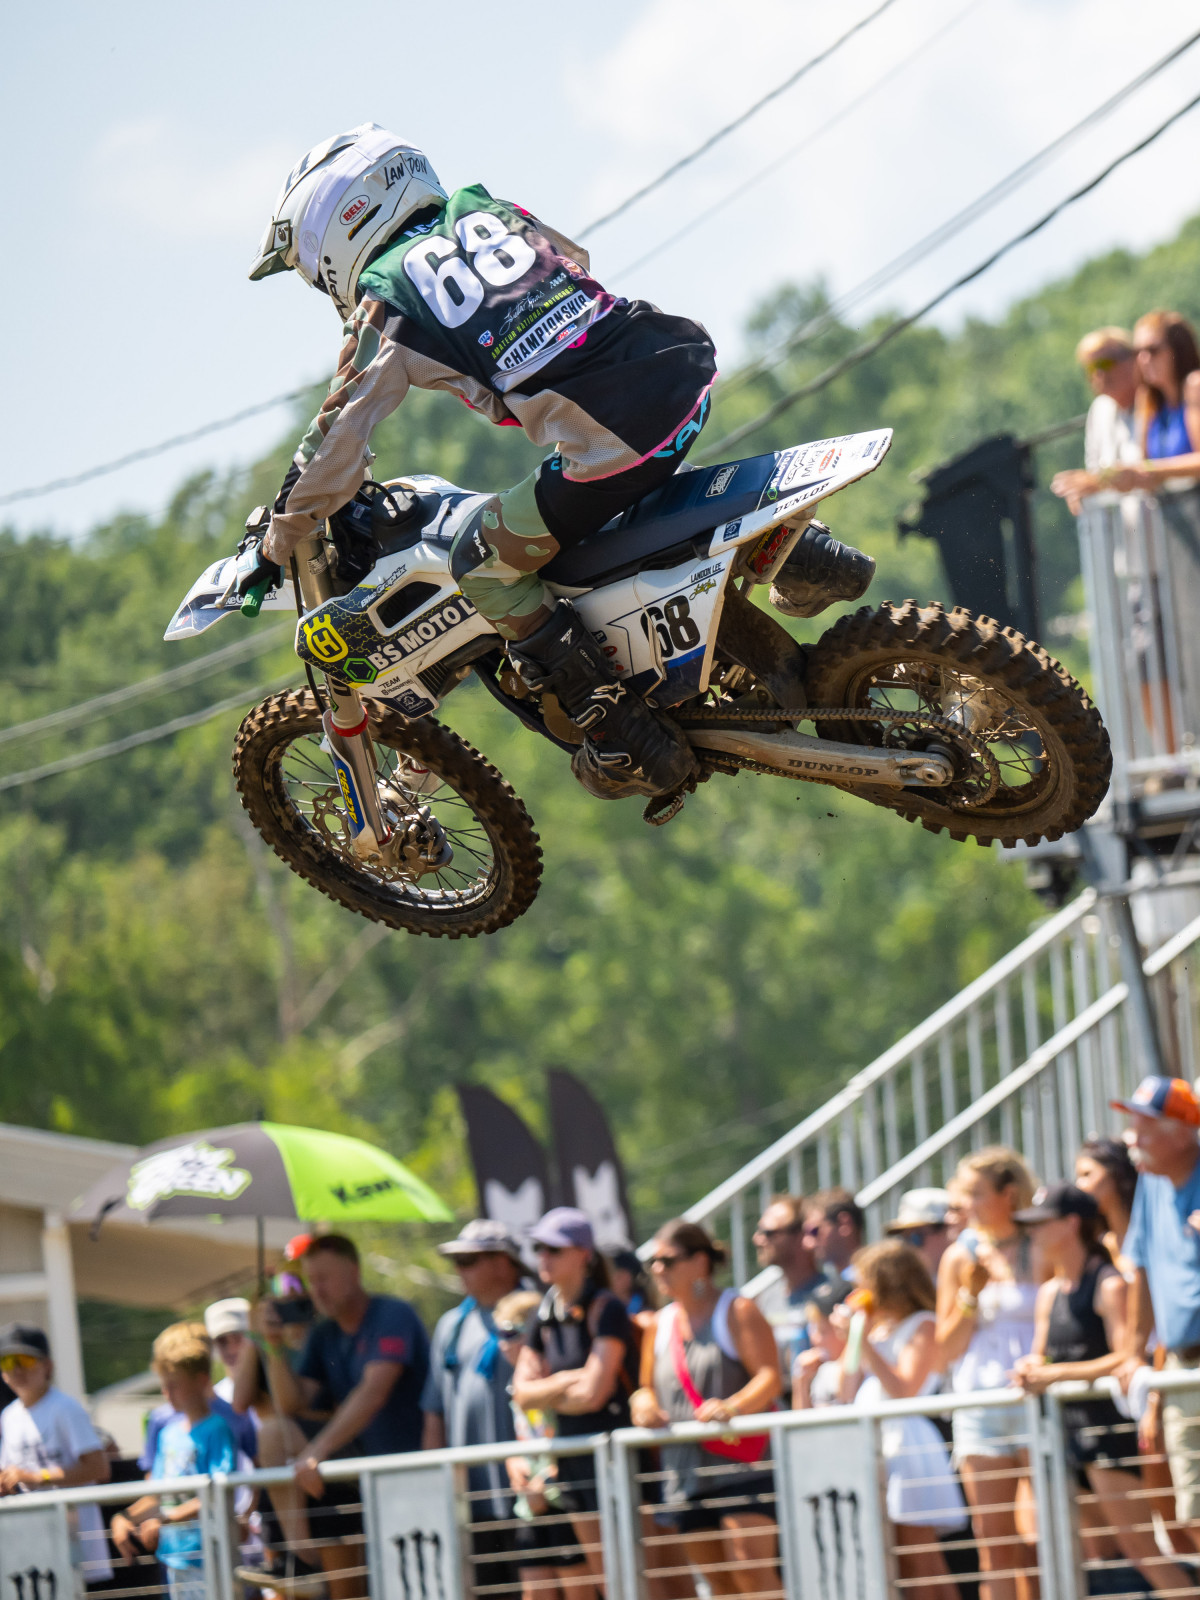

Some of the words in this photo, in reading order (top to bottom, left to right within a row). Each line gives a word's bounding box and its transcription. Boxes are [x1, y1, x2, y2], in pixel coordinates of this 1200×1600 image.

[342, 199, 366, 222] BELL
[403, 211, 536, 329] 68
[491, 330, 517, 360] AMATEUR
[516, 306, 544, 332] NATIONAL
[503, 293, 588, 369] CHAMPIONSHIP
[772, 482, 830, 515] DUNLOP
[690, 569, 711, 583] LANDON
[712, 562, 722, 573] LEE
[367, 643, 403, 670] B'S
[396, 606, 461, 654] MOTO
[640, 595, 701, 659] 68
[378, 676, 400, 689] TEAM
[787, 759, 879, 777] DUNLOP
